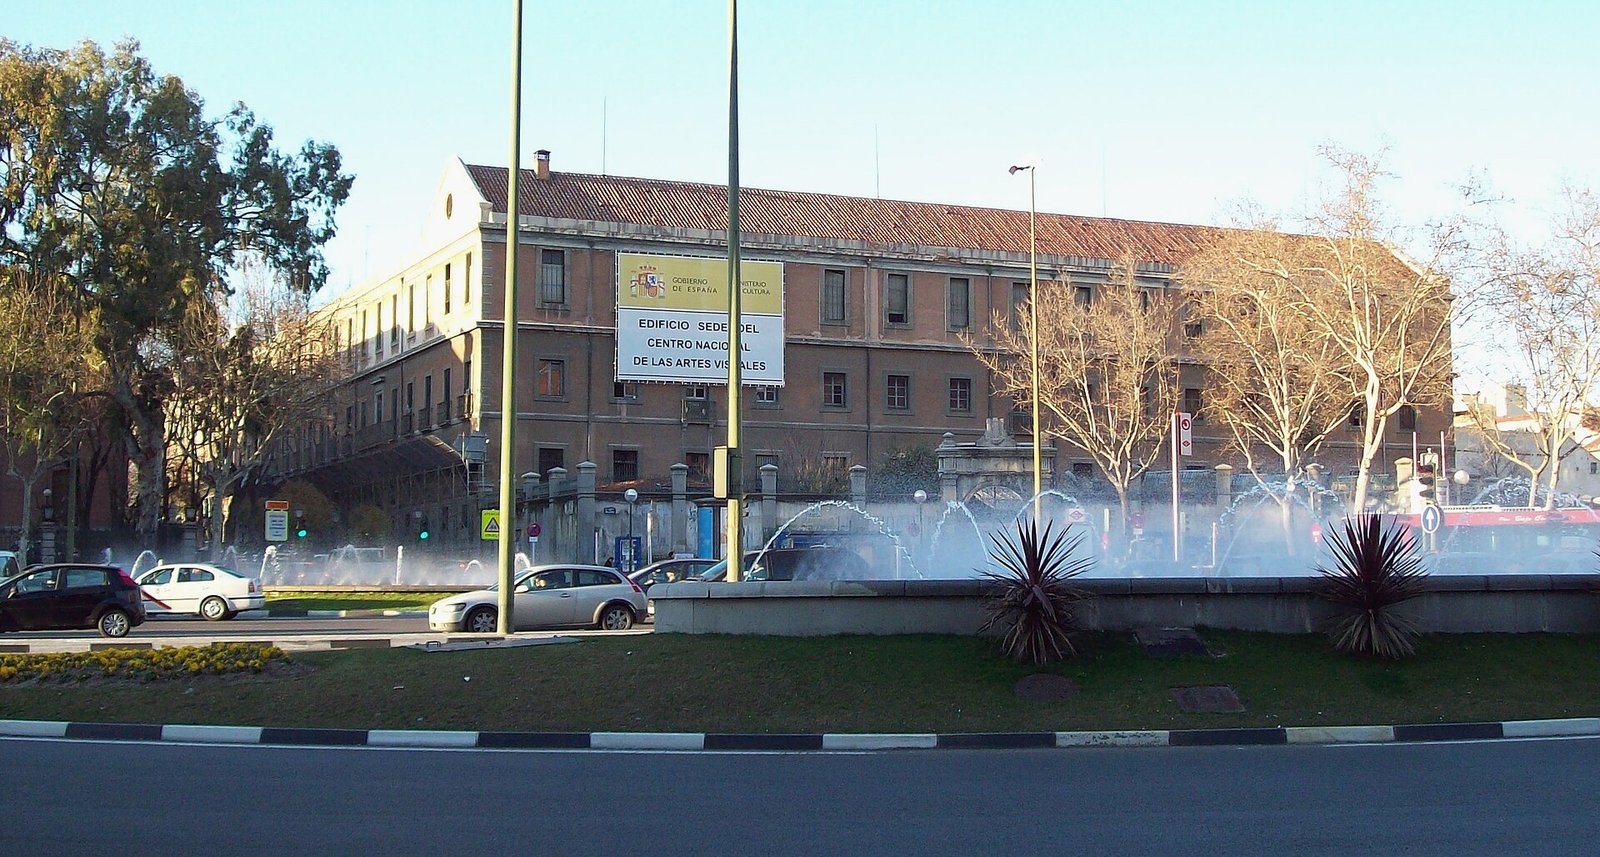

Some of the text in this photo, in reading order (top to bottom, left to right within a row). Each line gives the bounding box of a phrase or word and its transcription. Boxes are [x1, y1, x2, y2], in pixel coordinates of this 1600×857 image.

[672, 276, 708, 286] GOBIERNO
[687, 286, 718, 294] ESPAÑA
[639, 319, 690, 331] EDIFICIO
[698, 322, 728, 332] SEDE
[647, 338, 751, 352] CENTRO NACIOL
[633, 356, 766, 371] DE LAS ARTES VISALES
